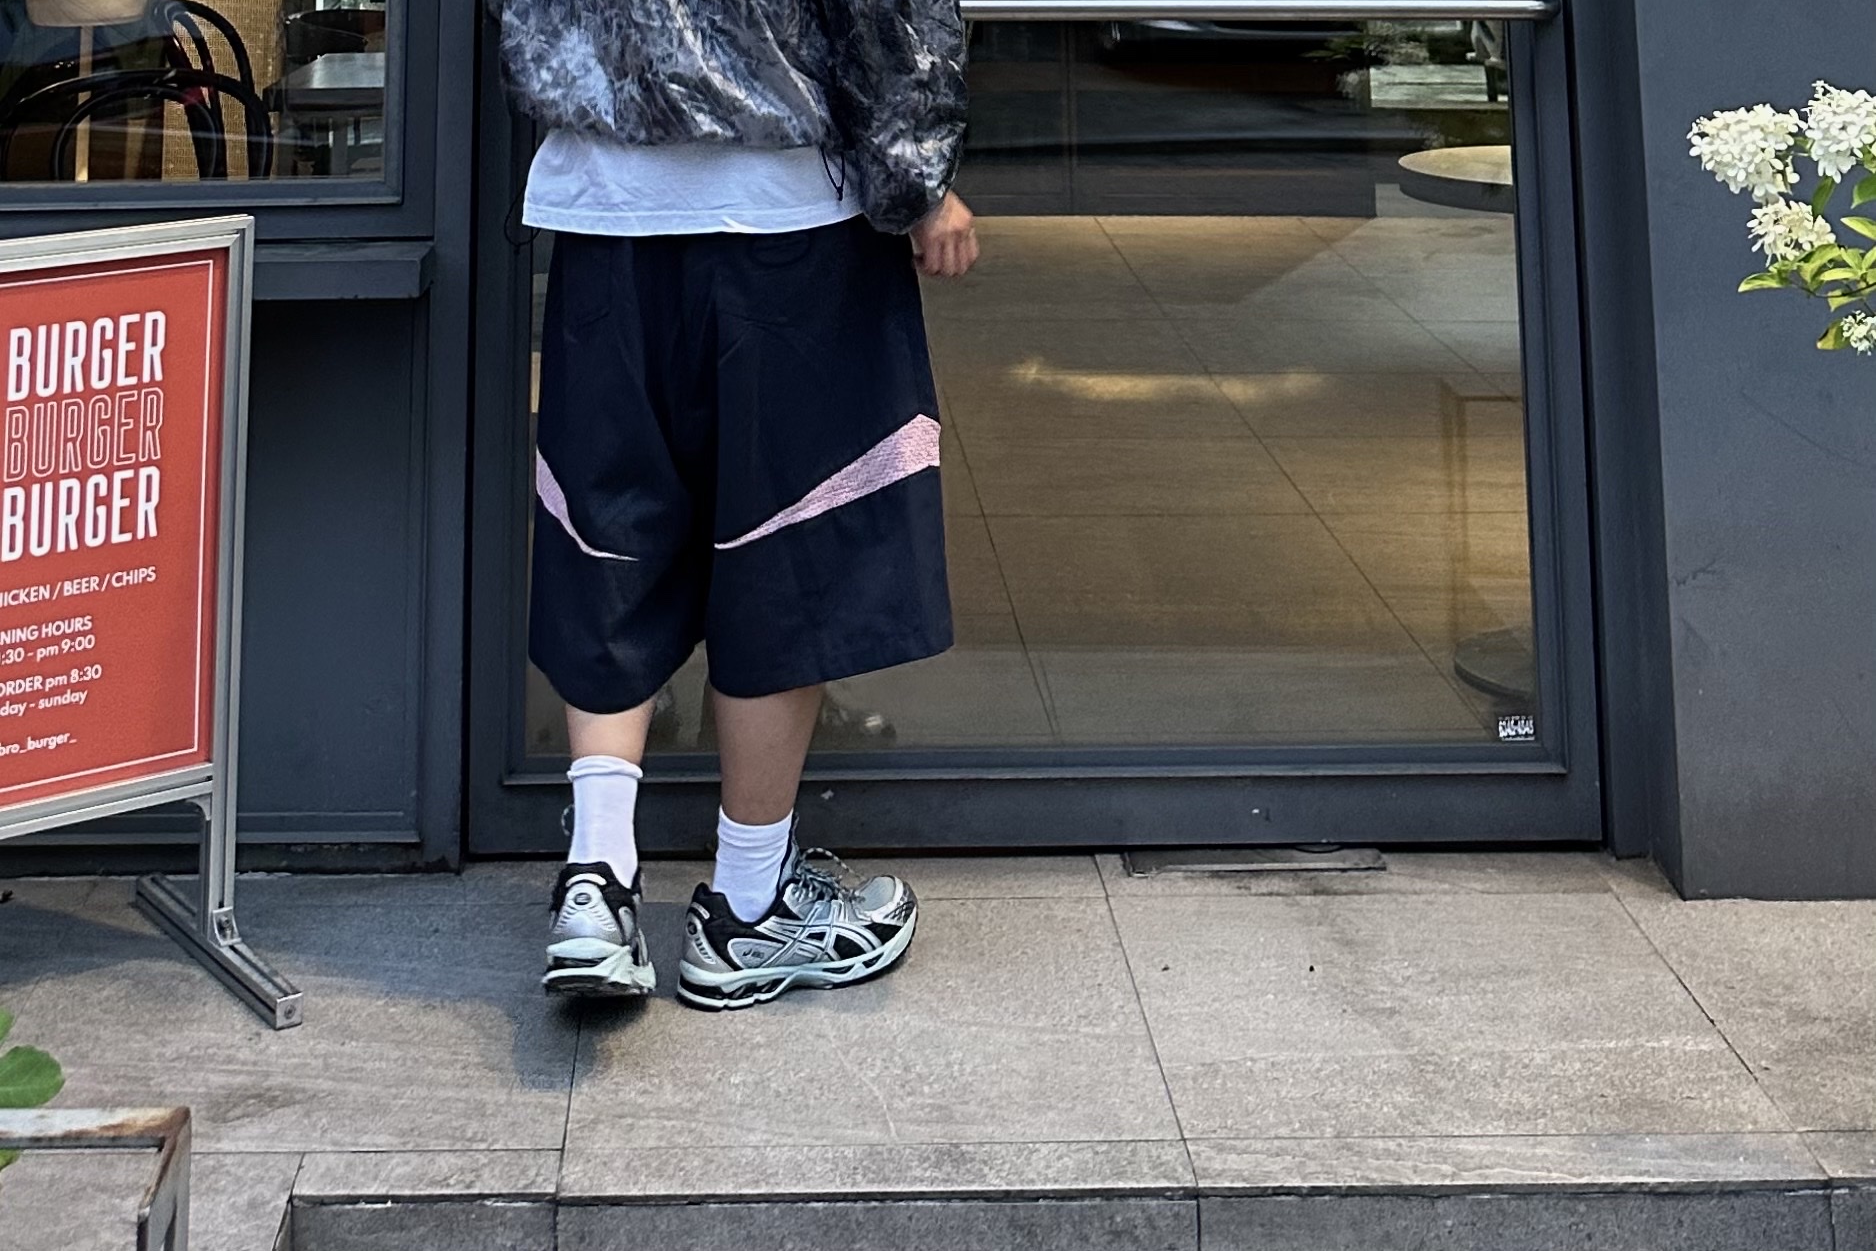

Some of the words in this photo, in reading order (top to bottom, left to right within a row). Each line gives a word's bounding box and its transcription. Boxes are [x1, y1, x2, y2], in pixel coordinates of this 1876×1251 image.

[7, 310, 166, 402] BURGER
[3, 387, 164, 482] BURGER
[0, 466, 160, 562] BURGER
[63, 576, 100, 597] BEER
[111, 566, 156, 587] CHIPS
[41, 615, 93, 638] HOURS
[36, 645, 59, 662] pm
[61, 634, 95, 654] 9:00
[45, 675, 67, 692] pm
[70, 664, 102, 684] 8:30
[38, 689, 88, 709] sunday
